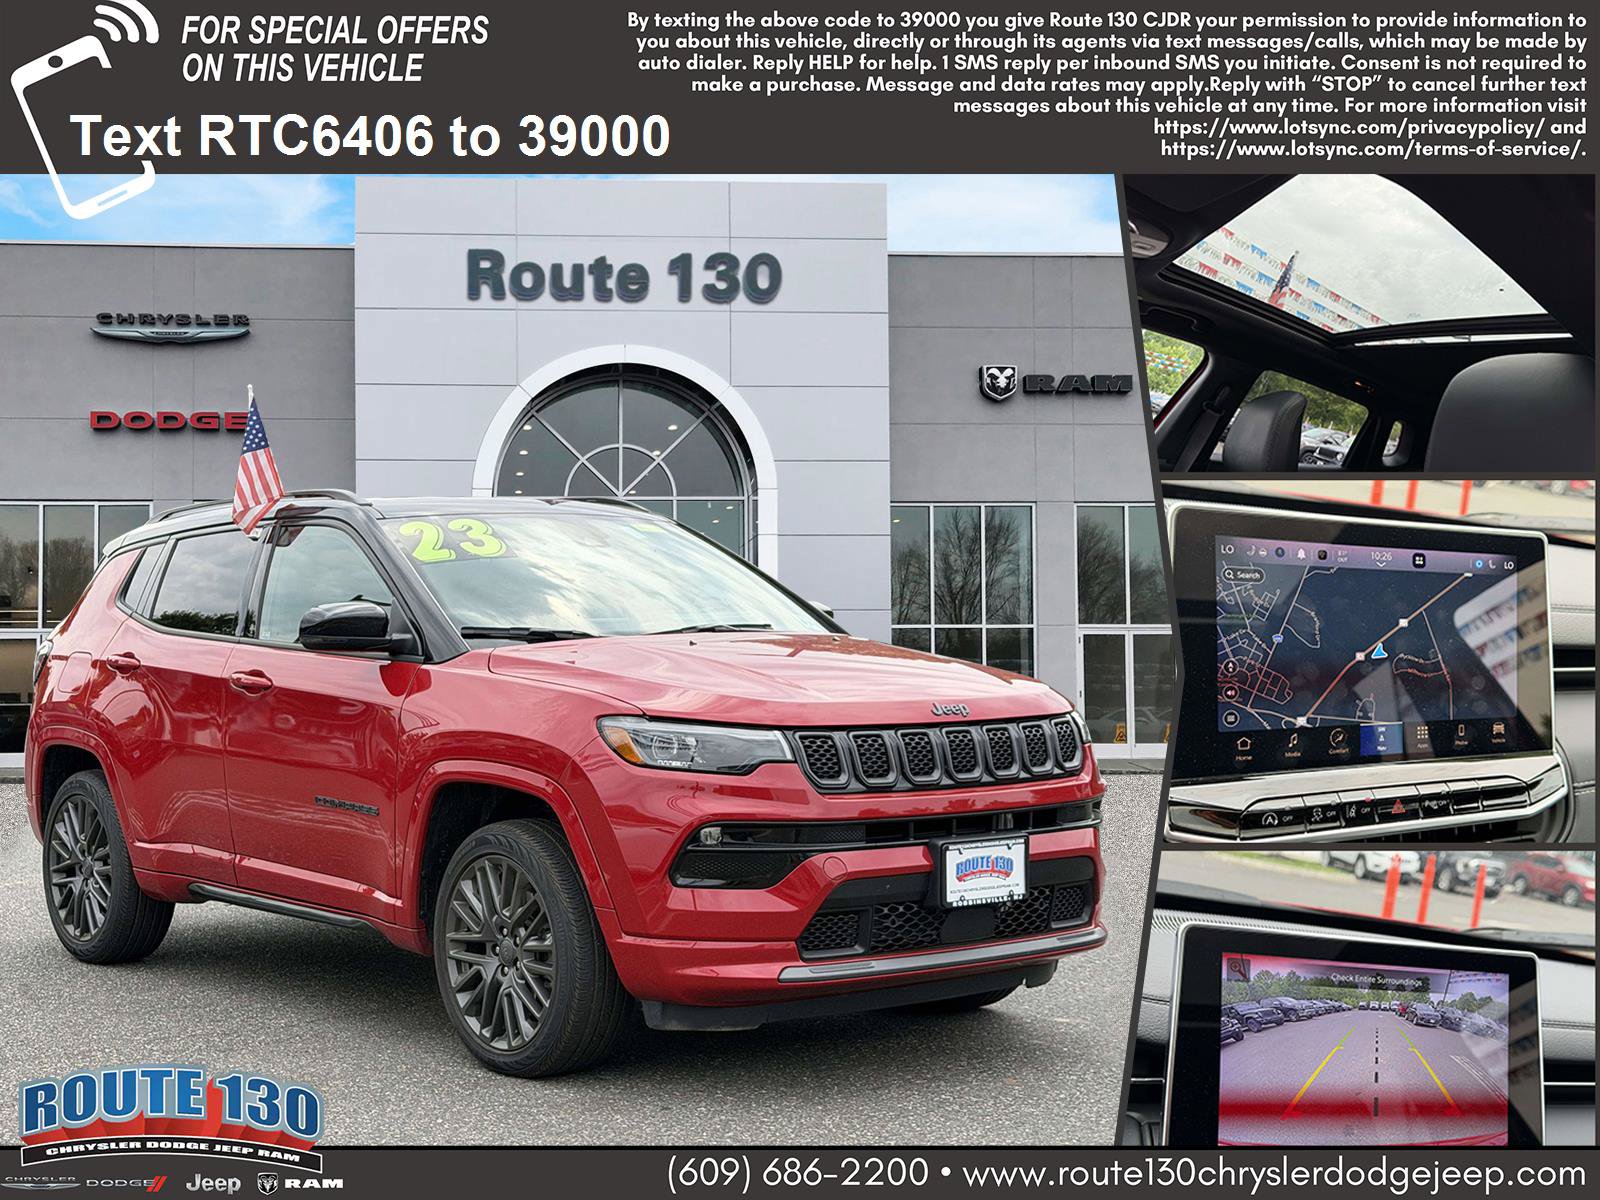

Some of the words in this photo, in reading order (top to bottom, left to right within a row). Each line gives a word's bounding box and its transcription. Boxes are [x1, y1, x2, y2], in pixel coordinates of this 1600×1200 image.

[467, 248, 650, 302] Route
[668, 252, 782, 304] 130
[96, 312, 250, 326] CHRYSLER
[1022, 374, 1133, 395] RAM
[90, 411, 248, 431] DODGE
[400, 518, 507, 563] 23
[1220, 544, 1235, 554] LO
[1370, 551, 1393, 561] 10:26
[1236, 570, 1261, 580] Search
[931, 702, 970, 717] Jeep
[1326, 810, 1337, 818] OFF
[1361, 806, 1371, 814] OFF
[1282, 815, 1294, 823] OFF
[956, 855, 992, 876] ROUTE
[994, 855, 1015, 873] 130
[1331, 972, 1354, 983] Check
[1355, 974, 1377, 984] Entire
[1377, 976, 1423, 988] Surroundings
